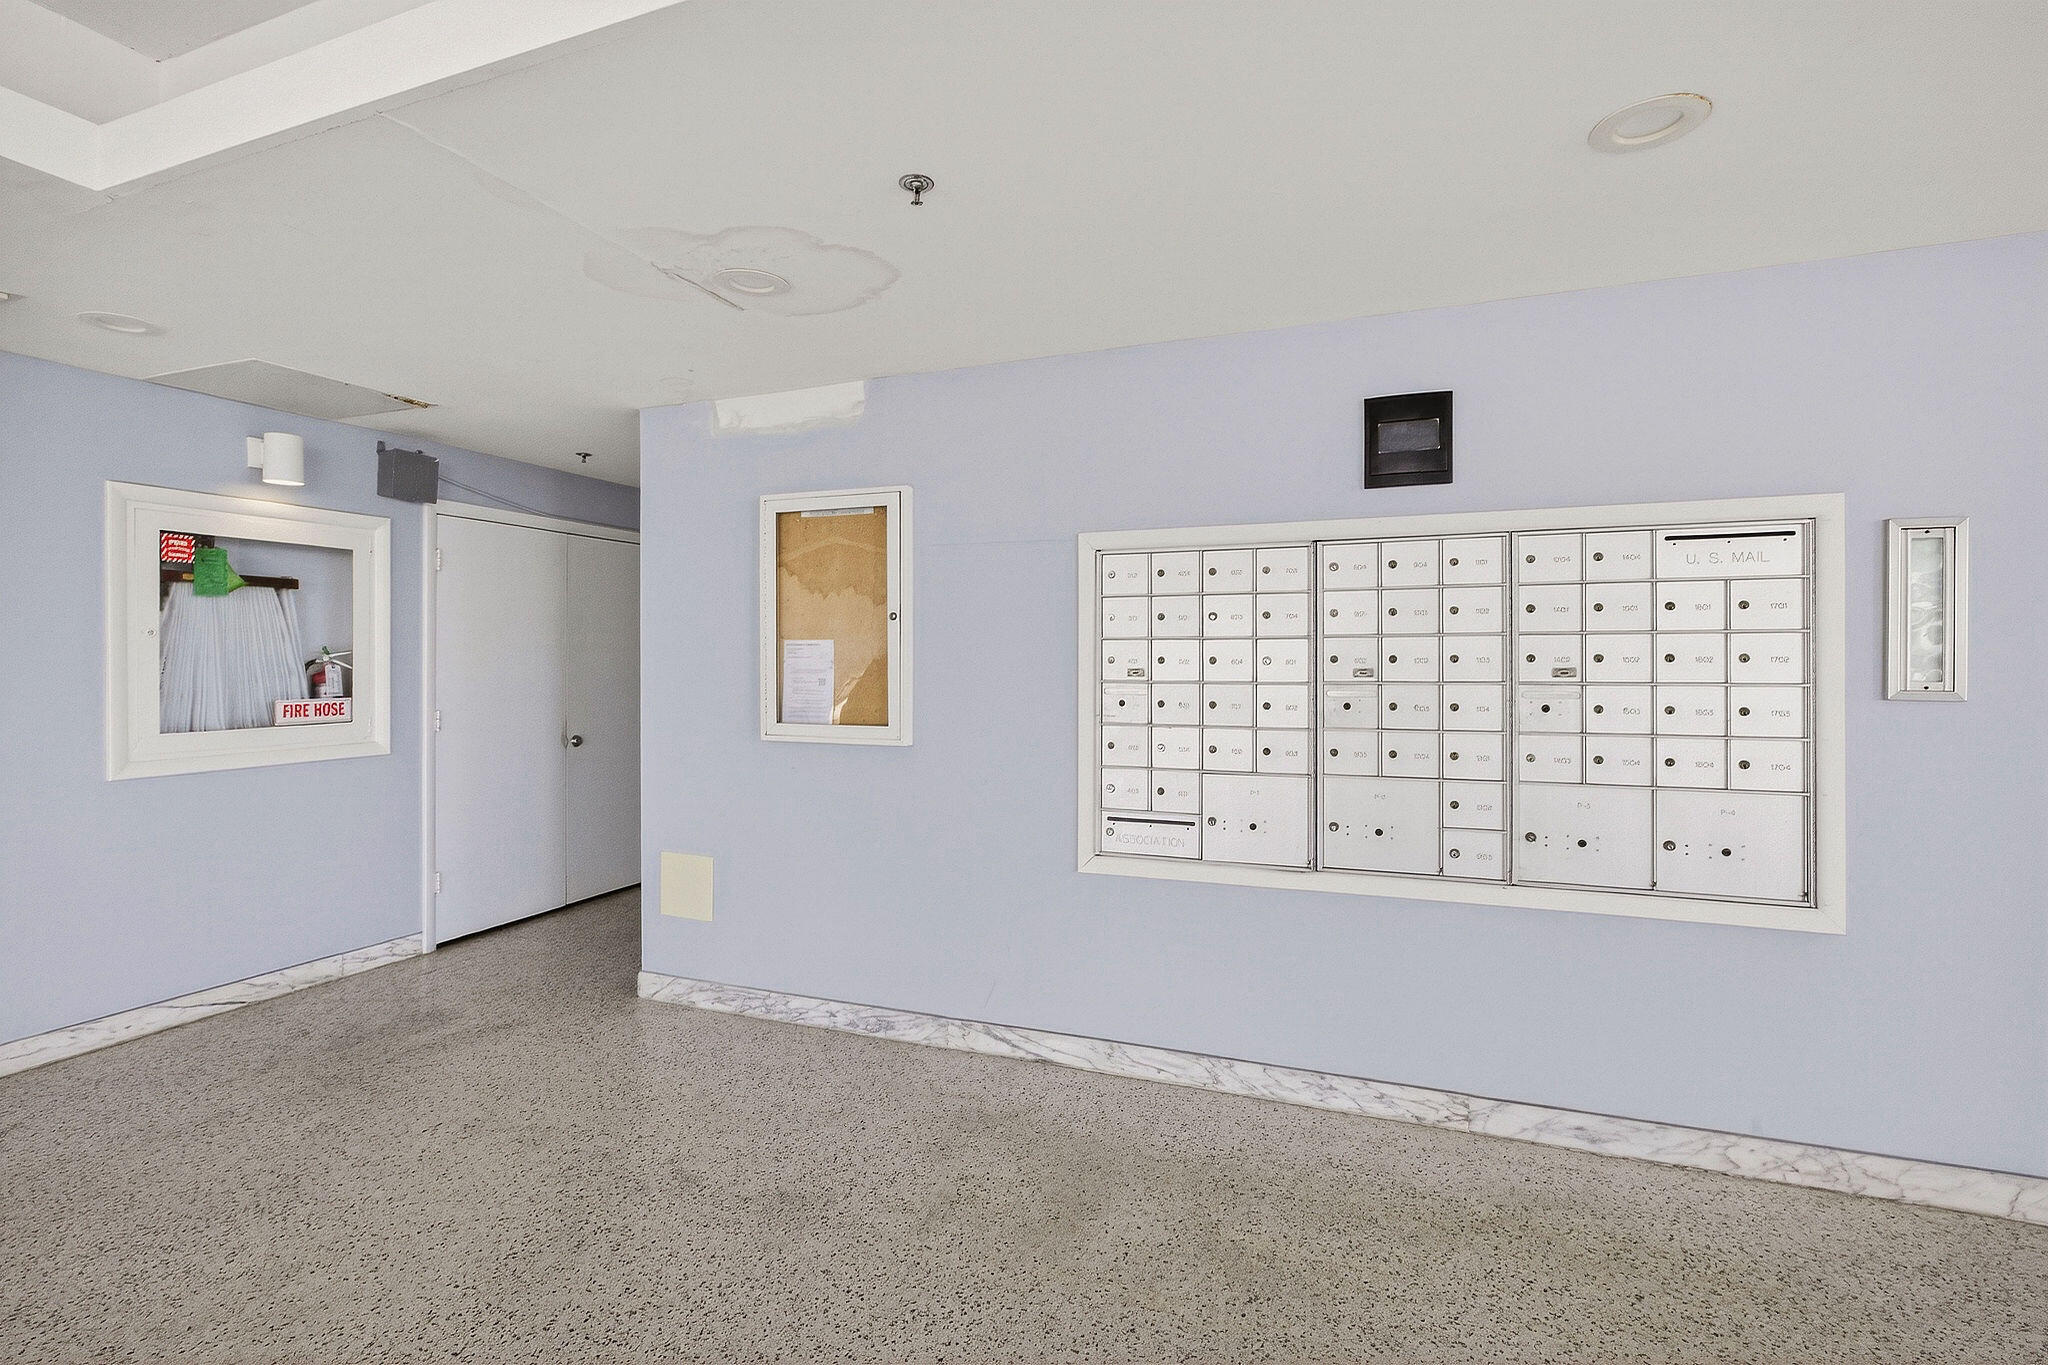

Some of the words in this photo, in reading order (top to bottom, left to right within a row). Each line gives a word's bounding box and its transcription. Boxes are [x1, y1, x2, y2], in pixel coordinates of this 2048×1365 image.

[1686, 553, 1700, 565] U.
[1708, 551, 1723, 564] S.
[1731, 551, 1771, 563] MAIL
[282, 704, 310, 718] FIRE
[314, 702, 345, 717] HOSE
[1115, 833, 1185, 848] ASSOCIATION
